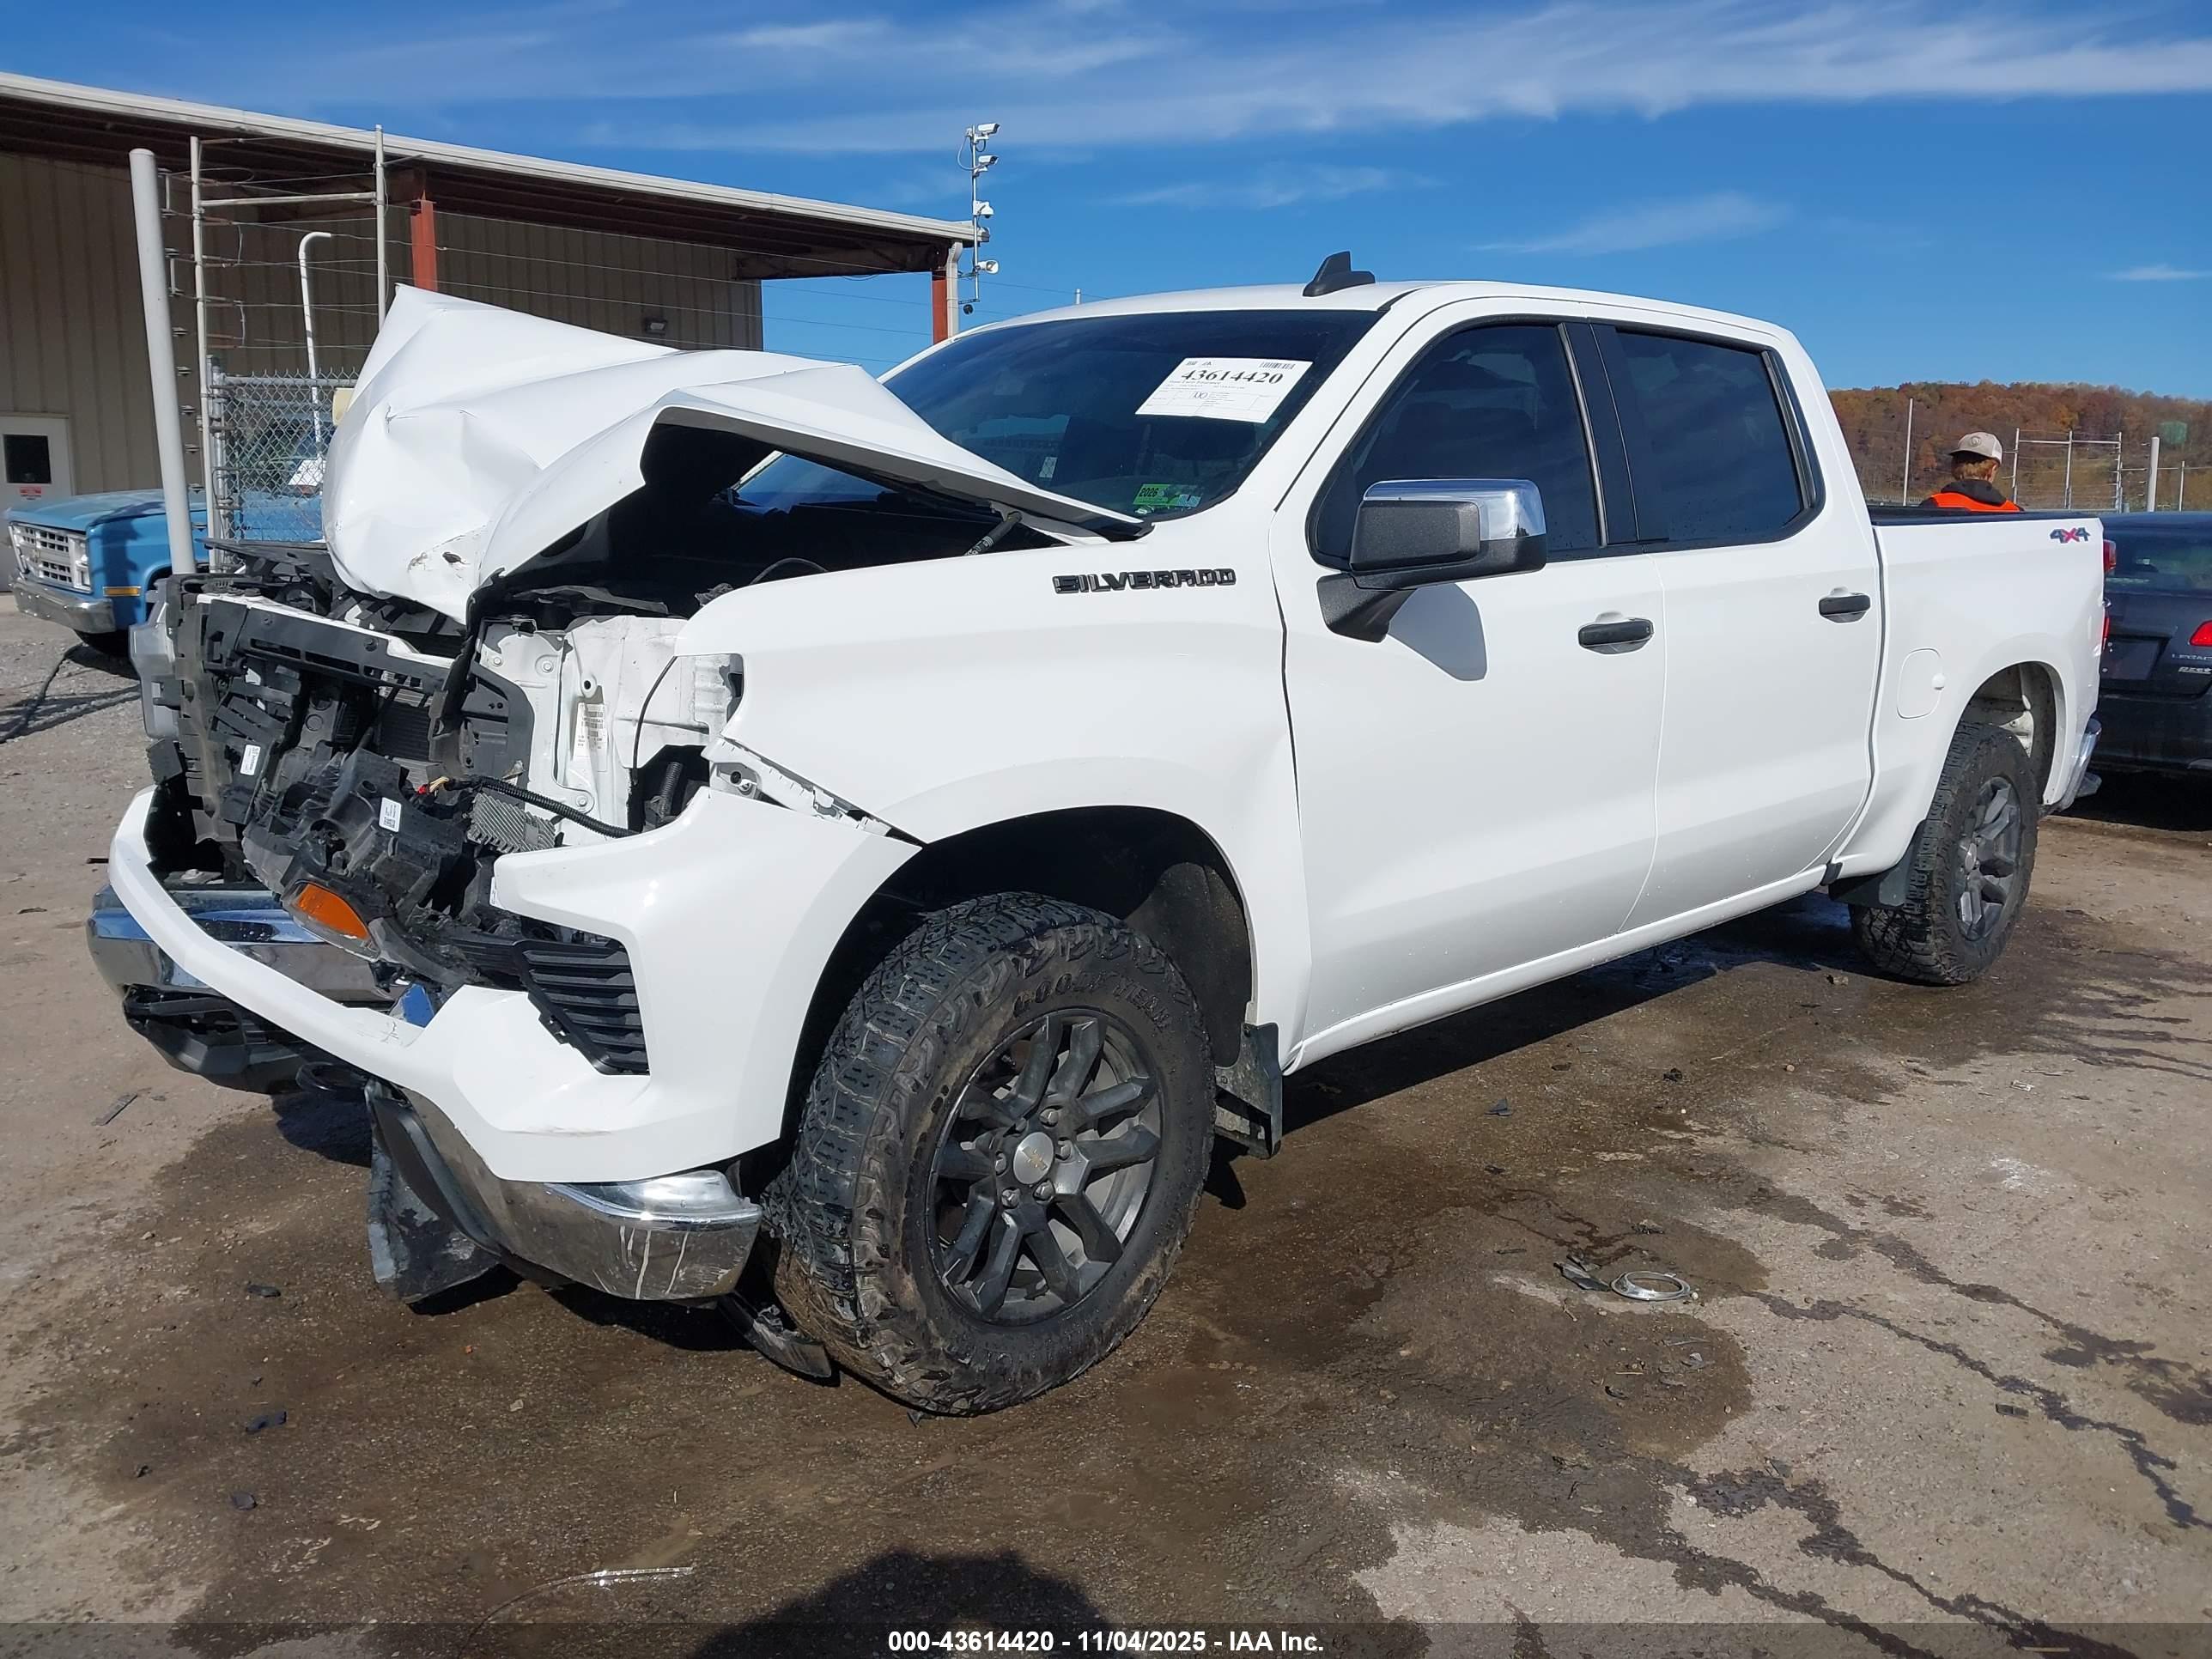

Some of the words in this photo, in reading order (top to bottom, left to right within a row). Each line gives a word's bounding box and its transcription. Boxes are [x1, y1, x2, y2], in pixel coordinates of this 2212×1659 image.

[1182, 369, 1284, 384] 43614420
[1139, 487, 1159, 497] 2026
[1052, 568, 1237, 594] SILVERADO
